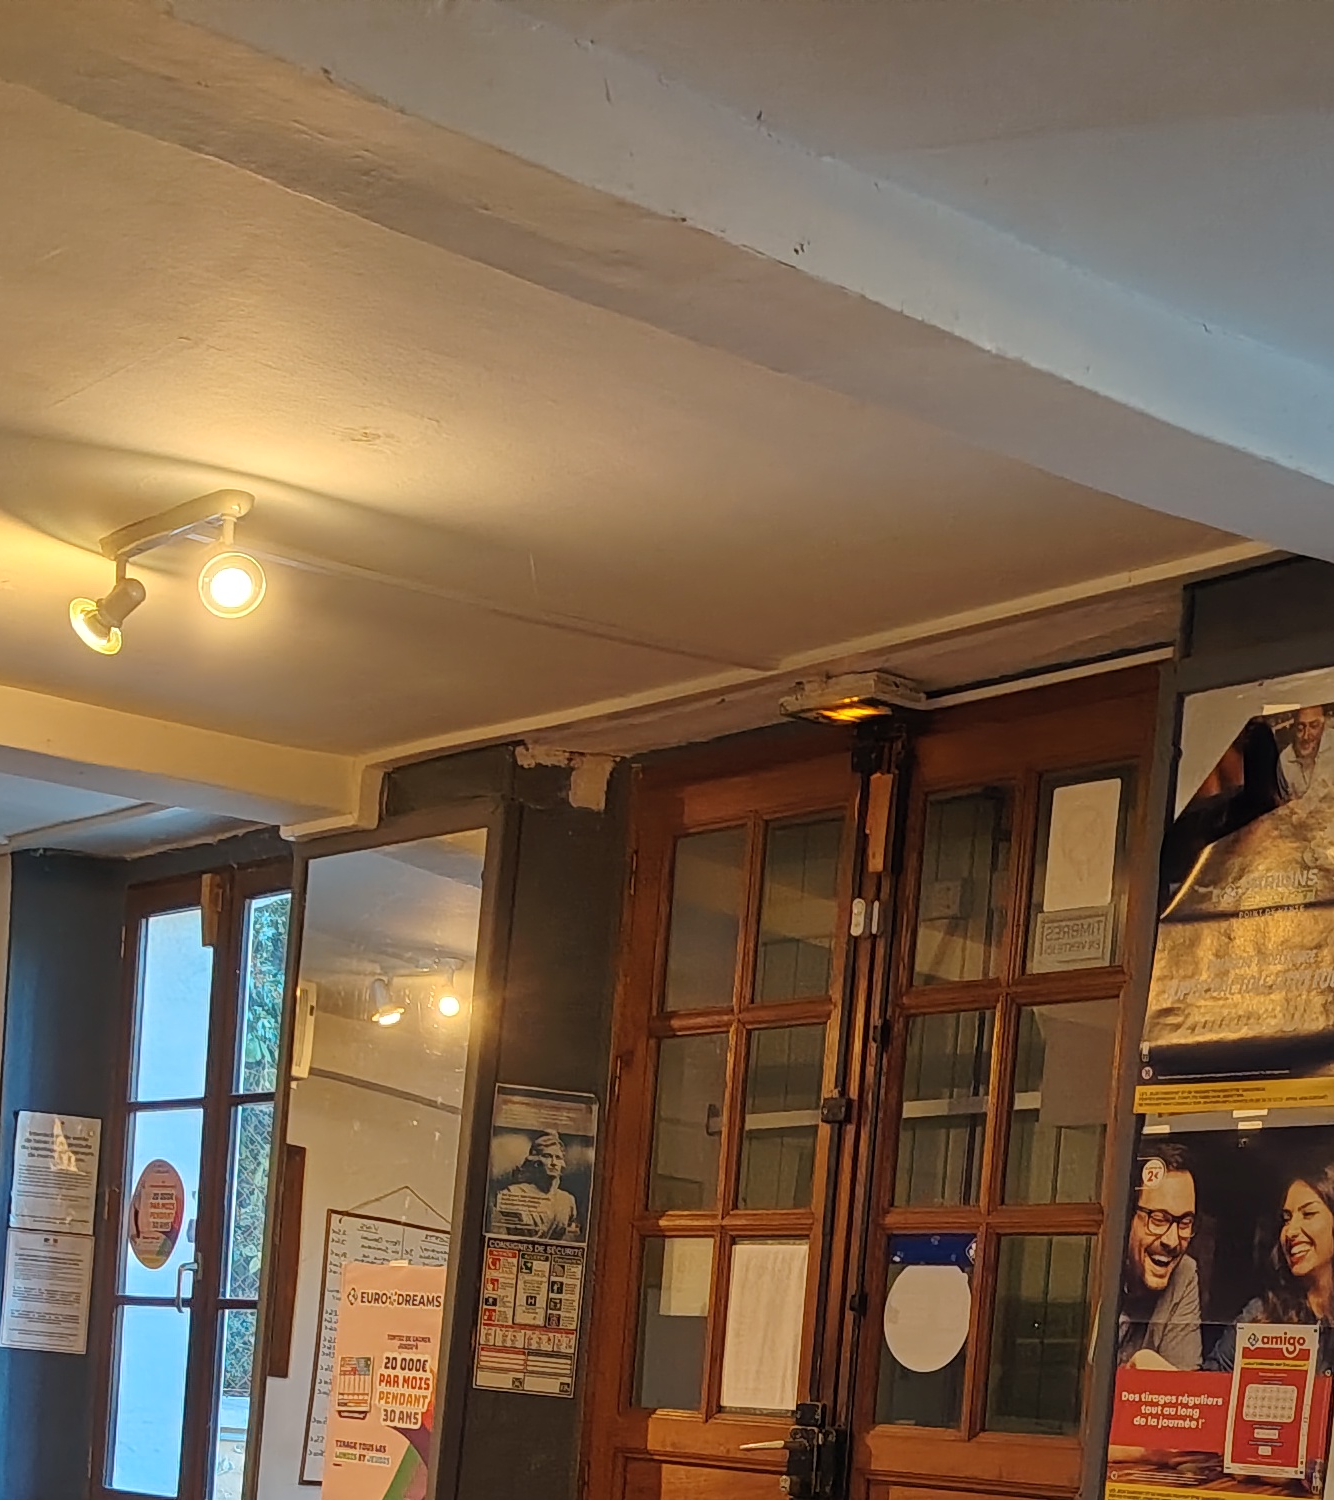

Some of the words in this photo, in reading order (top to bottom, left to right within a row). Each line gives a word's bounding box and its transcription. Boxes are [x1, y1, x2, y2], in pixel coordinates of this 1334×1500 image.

[489, 1240, 532, 1252] CONSIGNES
[534, 1245, 545, 1253] DE
[1261, 1332, 1306, 1355] amigo
[384, 1356, 397, 1370] 20
[400, 1358, 428, 1372] 000€
[379, 1373, 399, 1388] PAR
[402, 1375, 430, 1390] MOIS
[378, 1391, 428, 1409] PENDANT
[1122, 1392, 1139, 1401] Des
[1141, 1392, 1176, 1404] tirages
[1178, 1394, 1223, 1406] réguliers
[383, 1409, 396, 1422] 30
[398, 1410, 419, 1425] ANS
[1141, 1404, 1162, 1414] tout
[1163, 1407, 1176, 1415] au
[1177, 1406, 1199, 1418] long
[1133, 1416, 1146, 1426] de
[1147, 1416, 1157, 1426] la
[1157, 1416, 1197, 1429] journée
